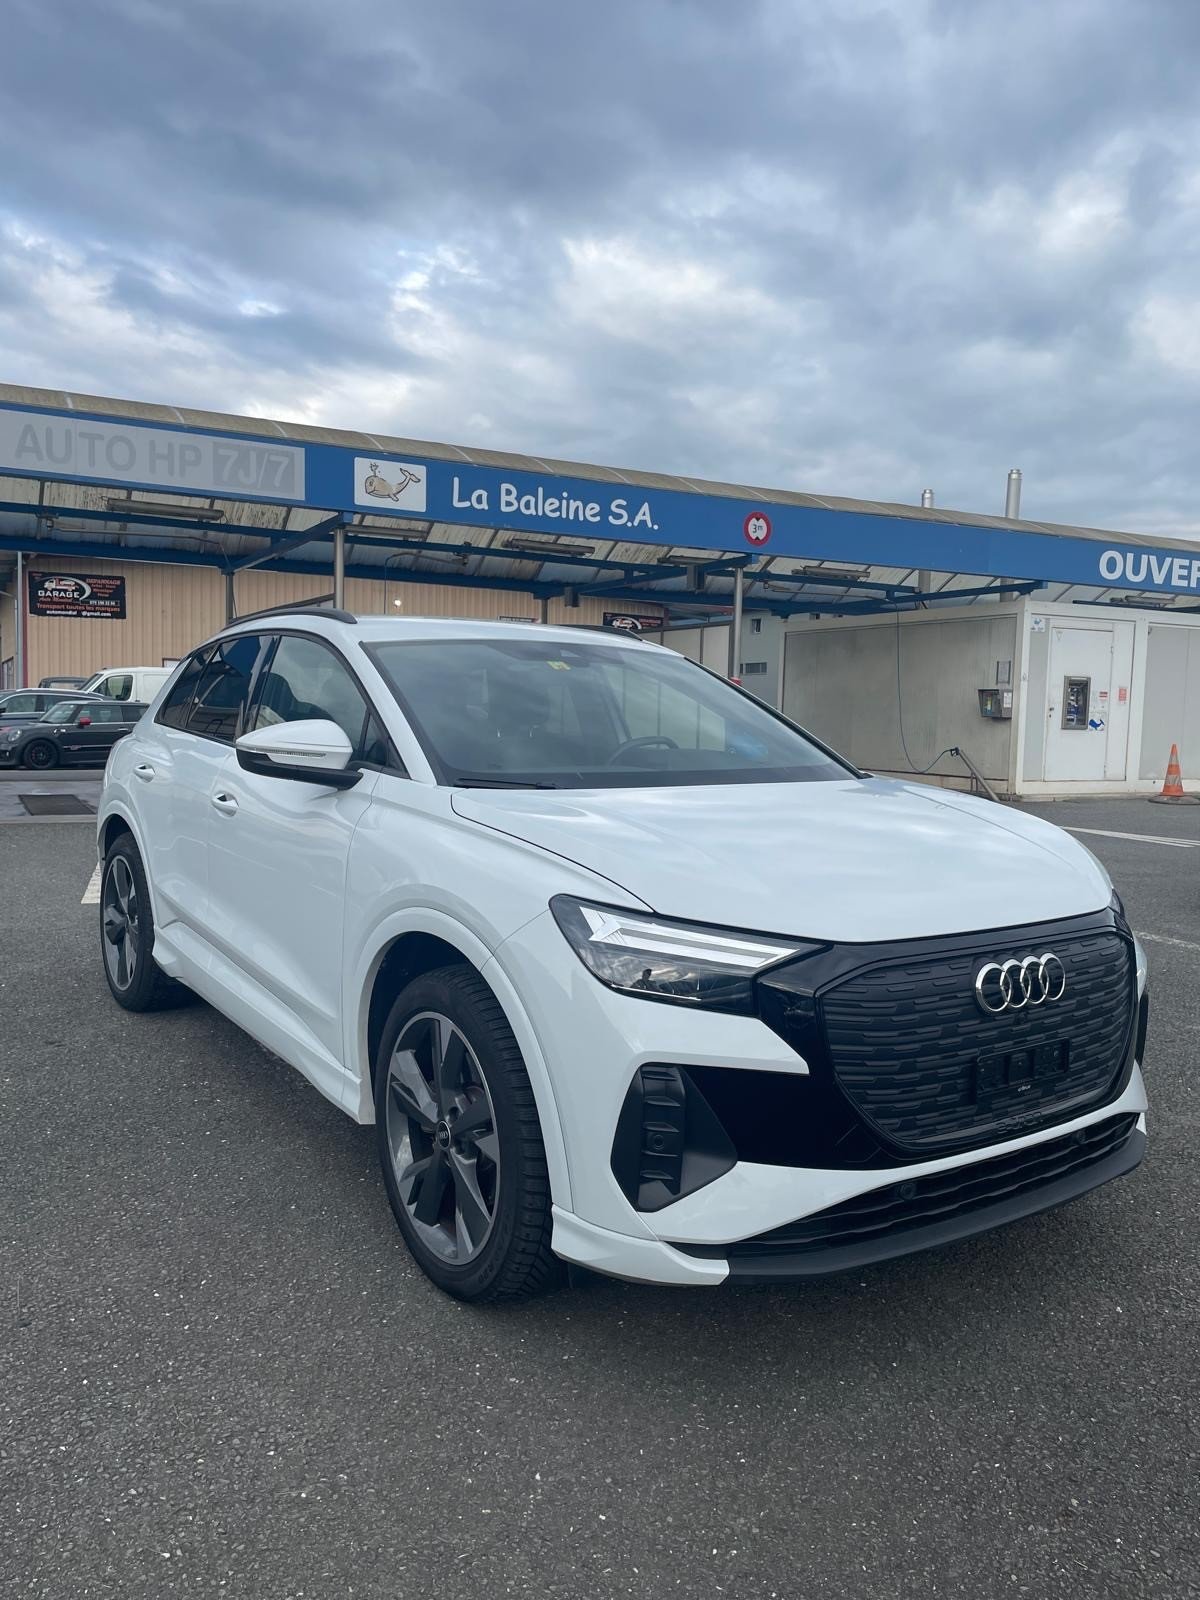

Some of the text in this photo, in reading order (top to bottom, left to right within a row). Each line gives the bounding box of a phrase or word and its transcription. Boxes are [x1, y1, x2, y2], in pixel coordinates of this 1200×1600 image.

[14, 423, 137, 473] AUTO
[150, 440, 201, 478] HP
[452, 476, 660, 530] La Baleine S.A.
[37, 590, 80, 598] GARAGE
[37, 602, 65, 611] Transport
